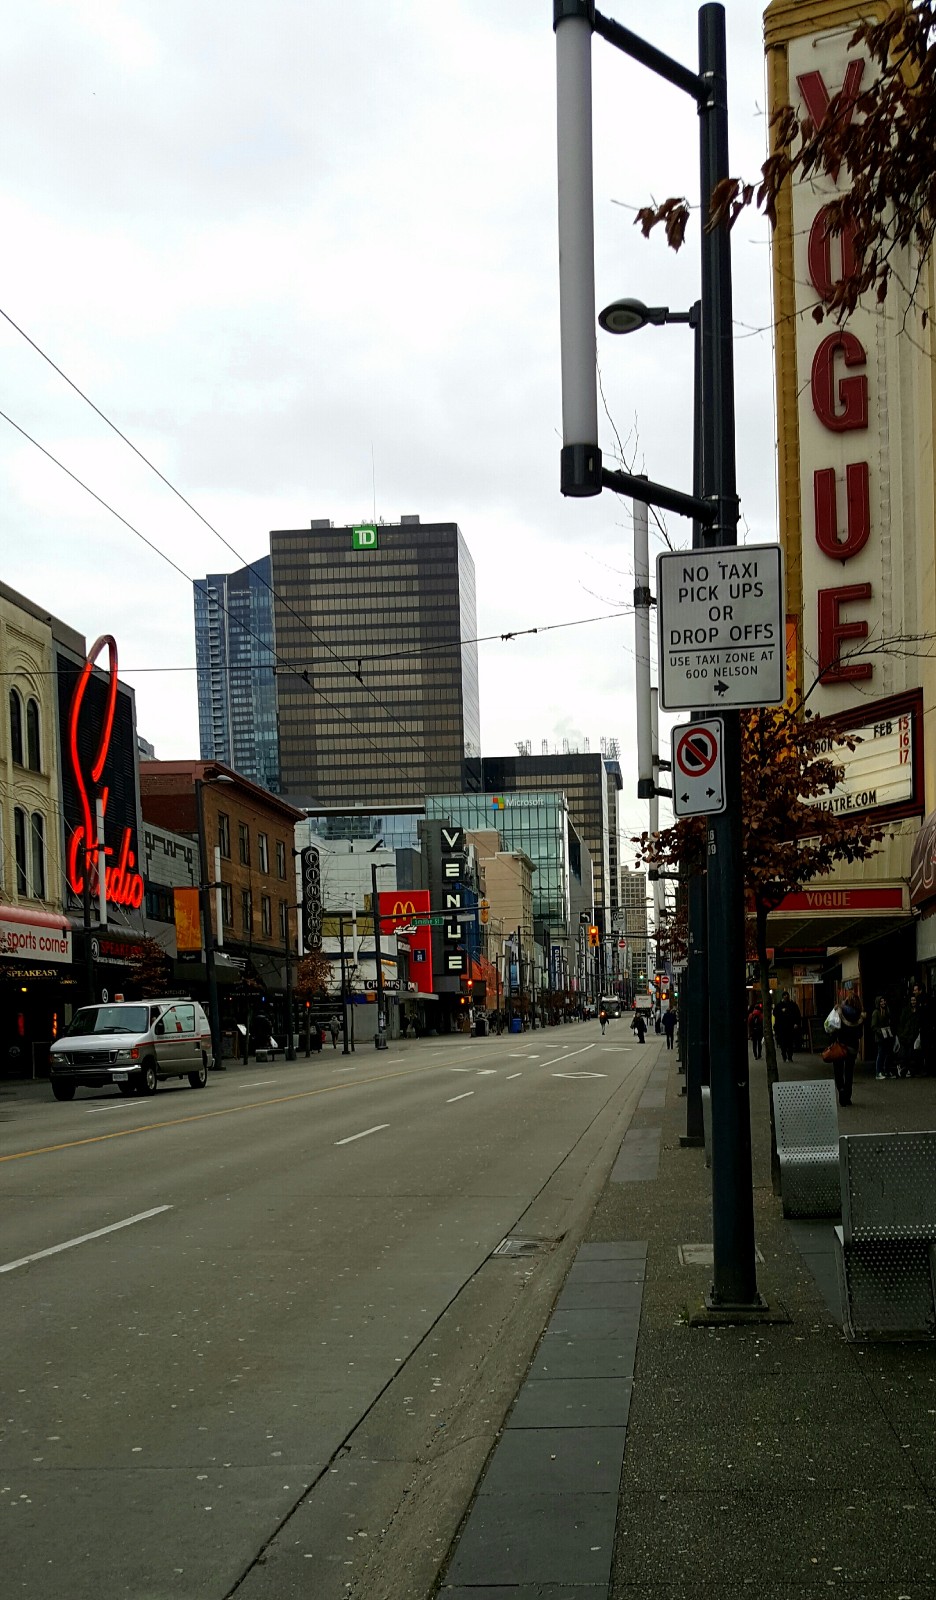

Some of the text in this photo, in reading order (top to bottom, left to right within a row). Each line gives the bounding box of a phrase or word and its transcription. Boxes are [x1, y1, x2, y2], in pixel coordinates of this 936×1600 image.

[796, 57, 872, 685] VOGUE
[355, 530, 375, 544] TD
[683, 562, 758, 583] NO TAXI
[678, 582, 764, 603] PICK UPS
[708, 605, 733, 621] OR
[670, 624, 774, 645] DROP OFFS
[670, 650, 774, 667] USE TAXI ZONE AT
[686, 665, 758, 679] 600 NELSON
[873, 716, 909, 738] FEB 15
[899, 733, 909, 748] 16
[899, 750, 909, 764] 17
[506, 798, 544, 806] Microsoft
[308, 852, 319, 944] CINEMA
[442, 829, 462, 969] VENUE
[806, 891, 851, 907] VOGUE
[7, 931, 37, 950] sports
[39, 937, 69, 954] corner
[6, 969, 59, 978] SPEAKEASY
[366, 980, 400, 989] CHMPS
